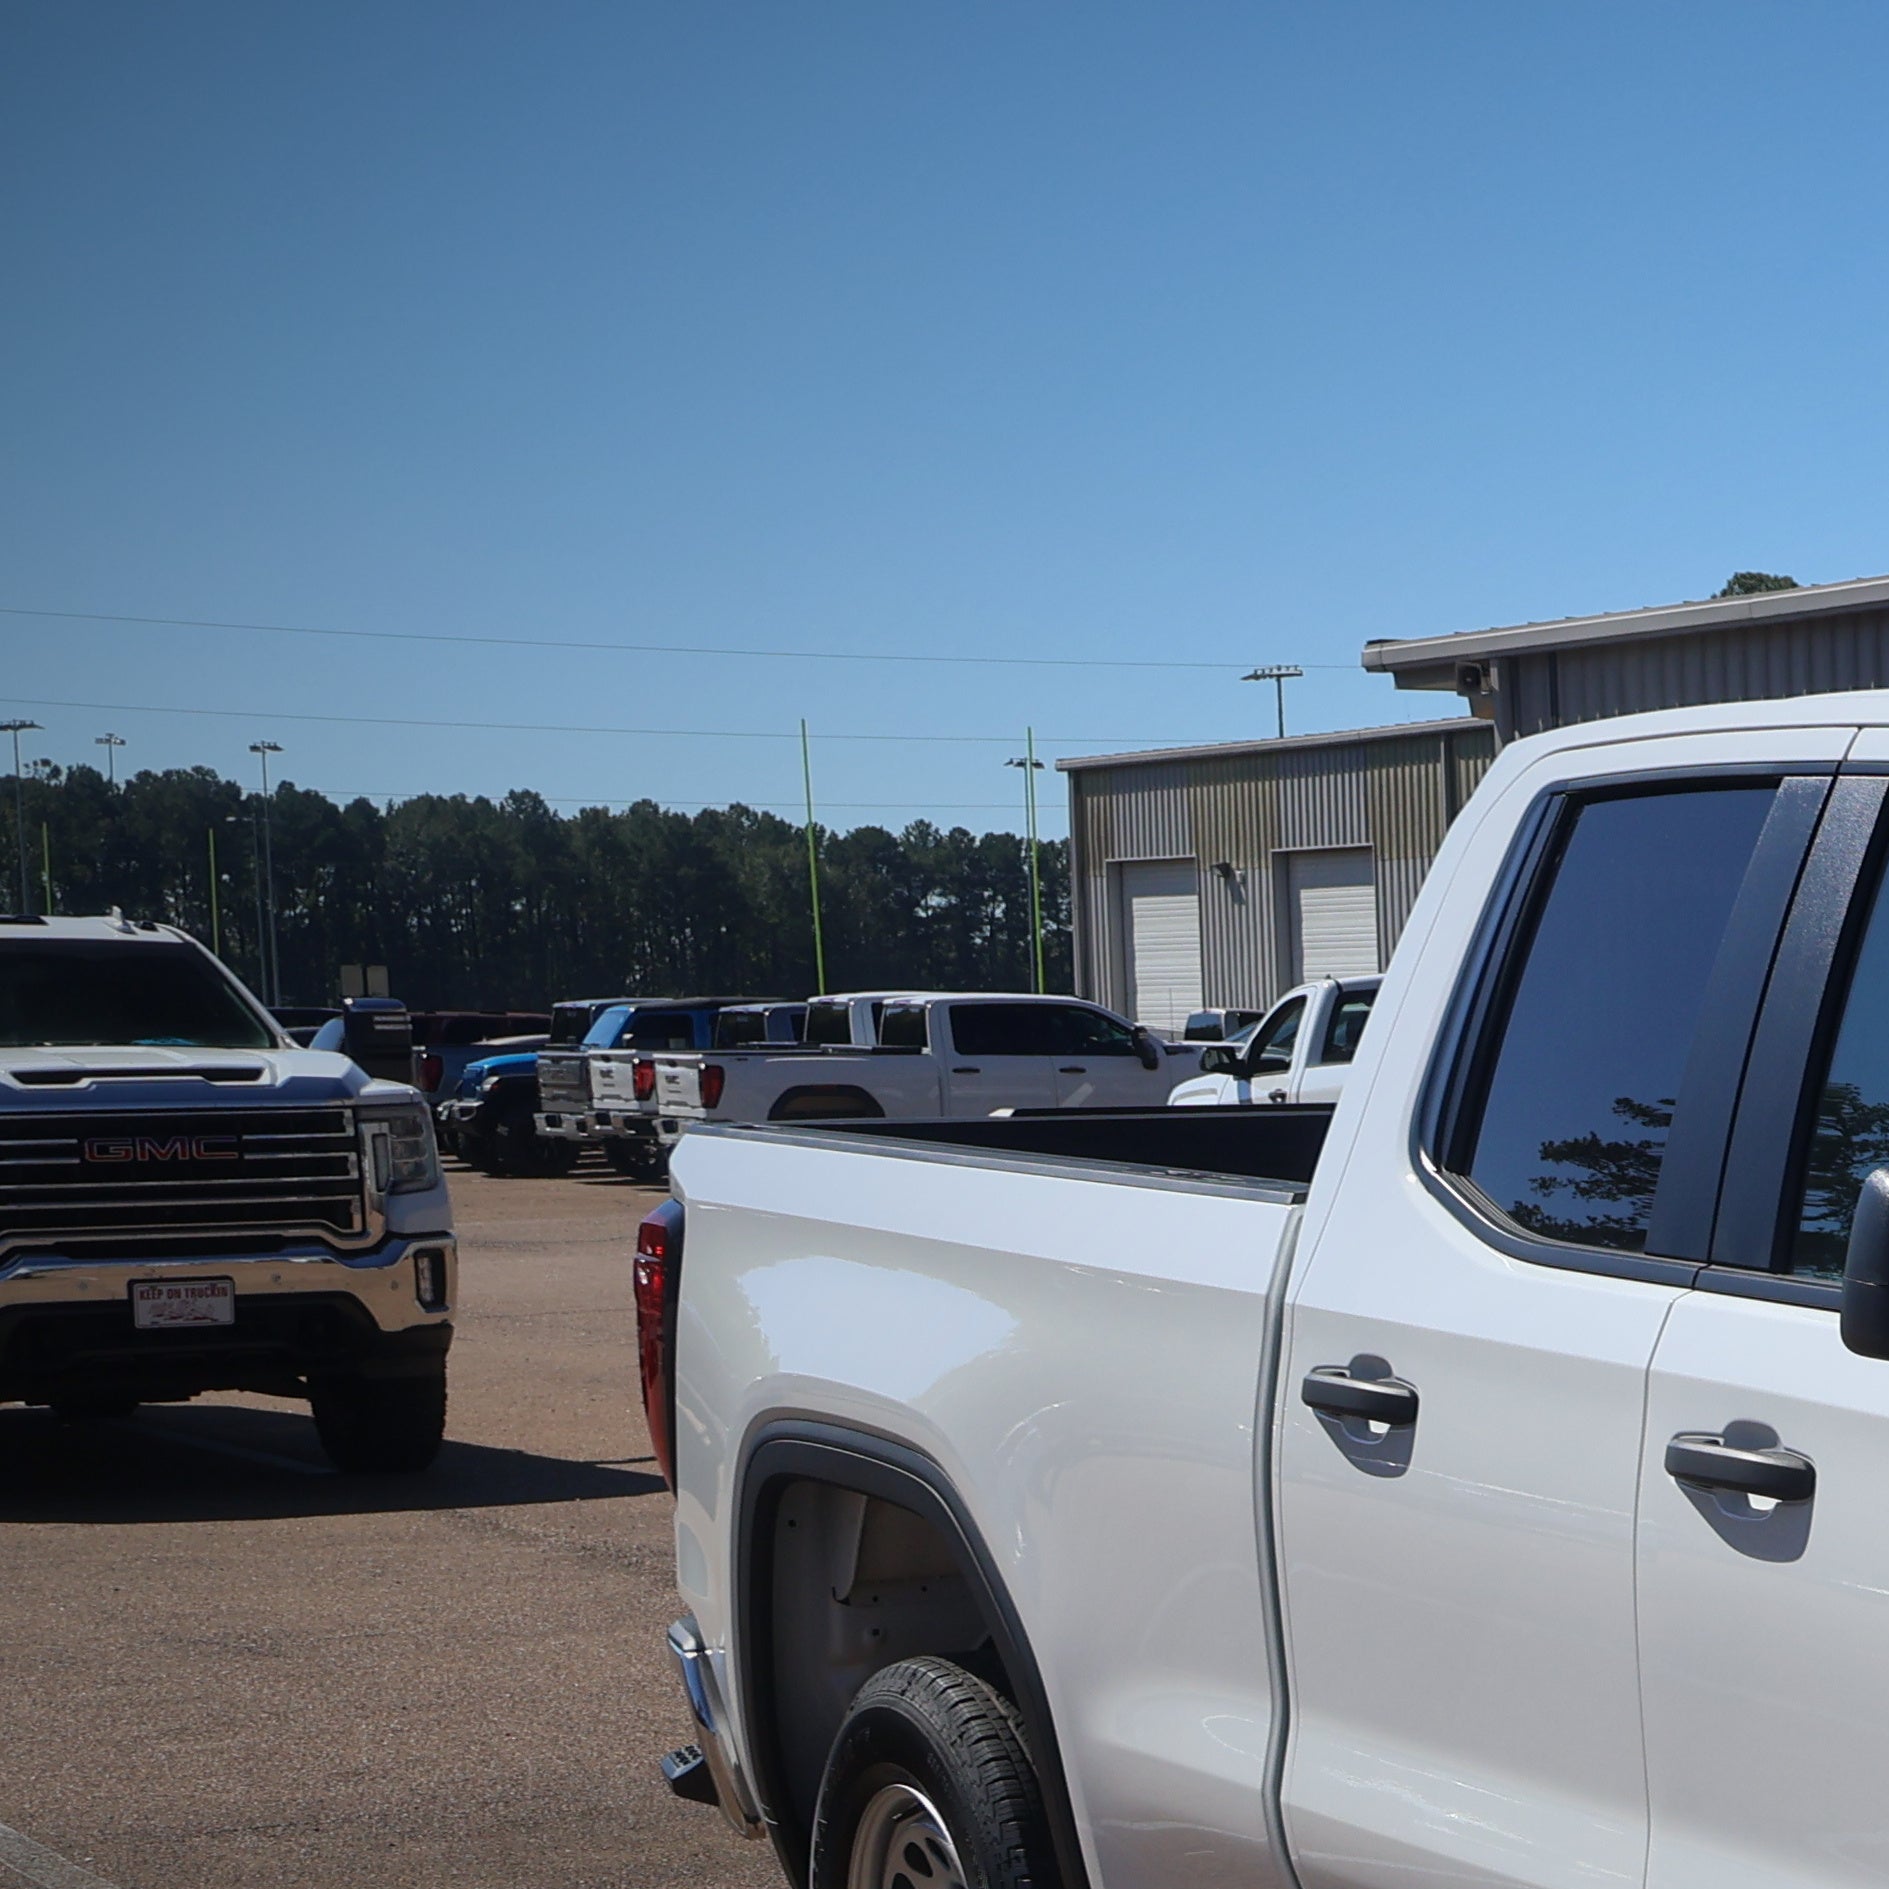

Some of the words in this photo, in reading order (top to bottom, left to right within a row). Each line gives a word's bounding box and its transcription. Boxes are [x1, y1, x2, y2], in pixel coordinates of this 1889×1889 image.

[86, 1135, 238, 1162] GMC
[139, 1287, 163, 1301] KEEP
[167, 1287, 182, 1300] ON
